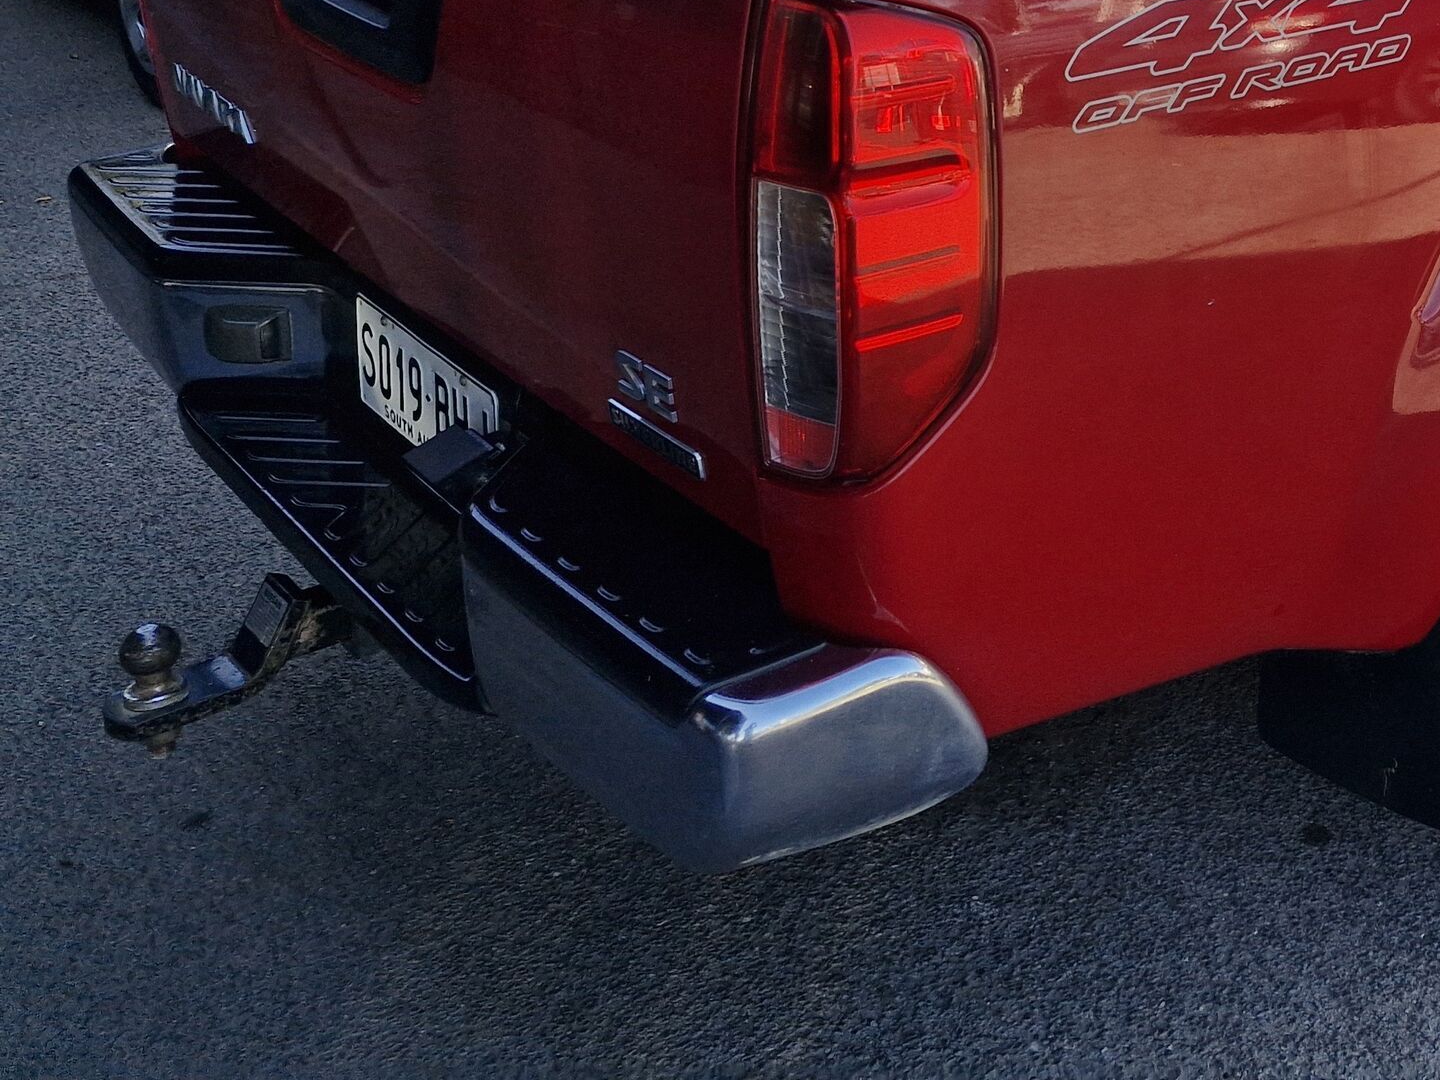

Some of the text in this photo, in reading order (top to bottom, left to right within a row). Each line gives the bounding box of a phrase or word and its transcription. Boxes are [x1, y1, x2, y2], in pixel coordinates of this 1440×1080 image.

[1072, 34, 1411, 134] OFF ROAD
[384, 404, 414, 438] SOUTH
[614, 349, 678, 423] SE
